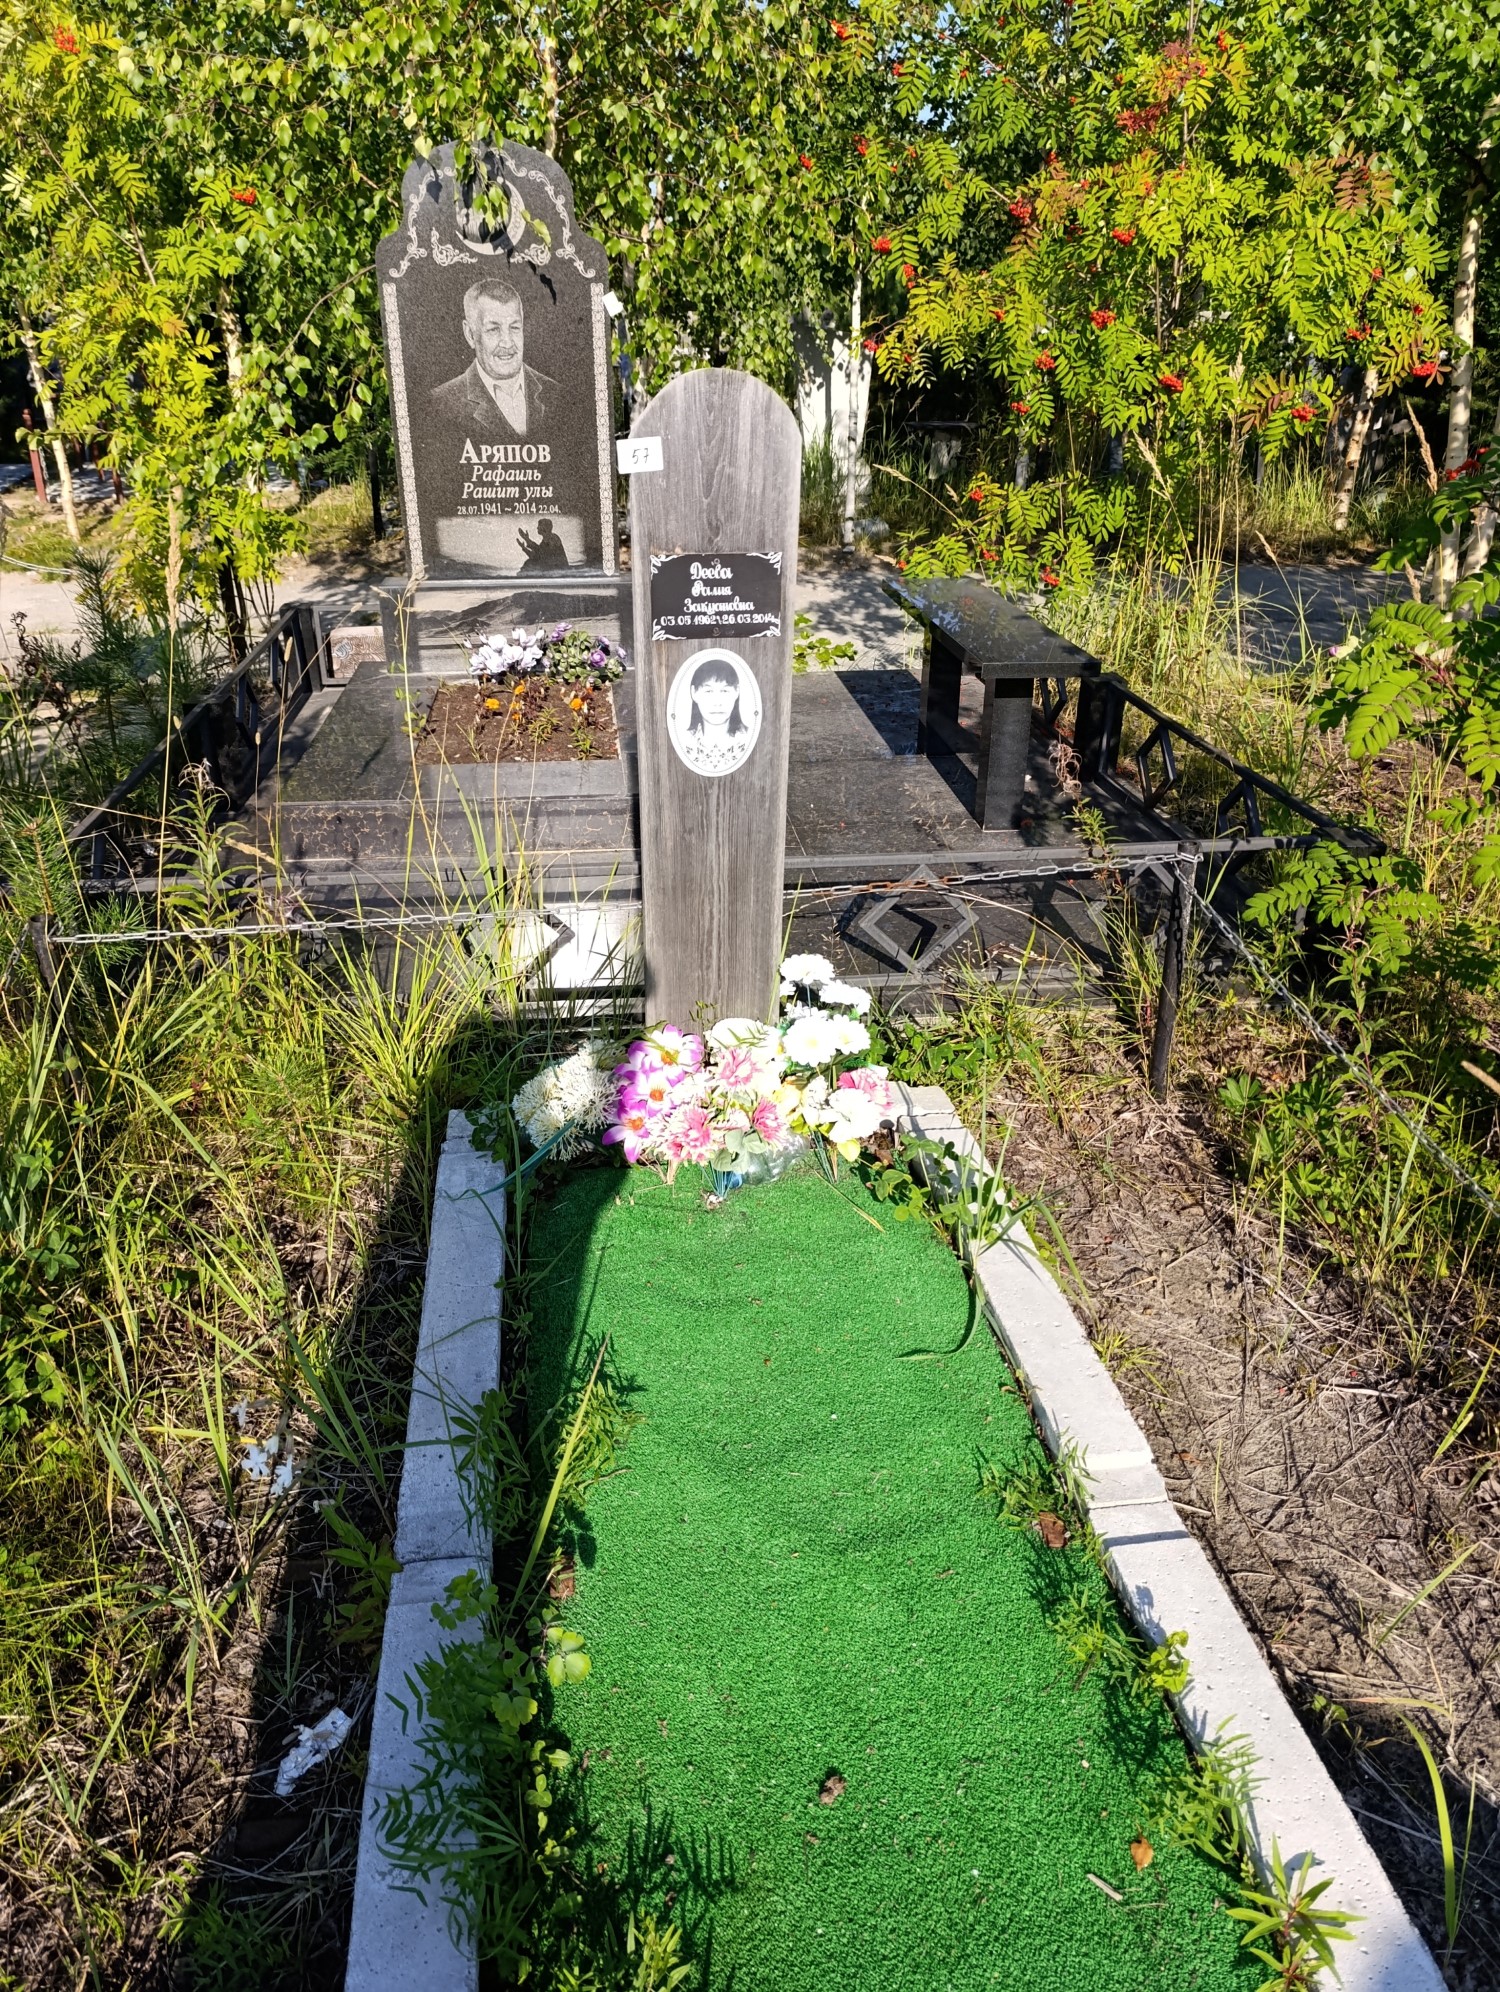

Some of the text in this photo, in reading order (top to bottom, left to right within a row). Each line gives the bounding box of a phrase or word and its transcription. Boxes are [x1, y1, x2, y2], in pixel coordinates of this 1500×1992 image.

[632, 447, 649, 465] 57
[471, 464, 542, 486] Рафаиль
[461, 482, 553, 502] Рашит улы
[513, 502, 537, 514] 2014
[689, 561, 733, 580] Деева
